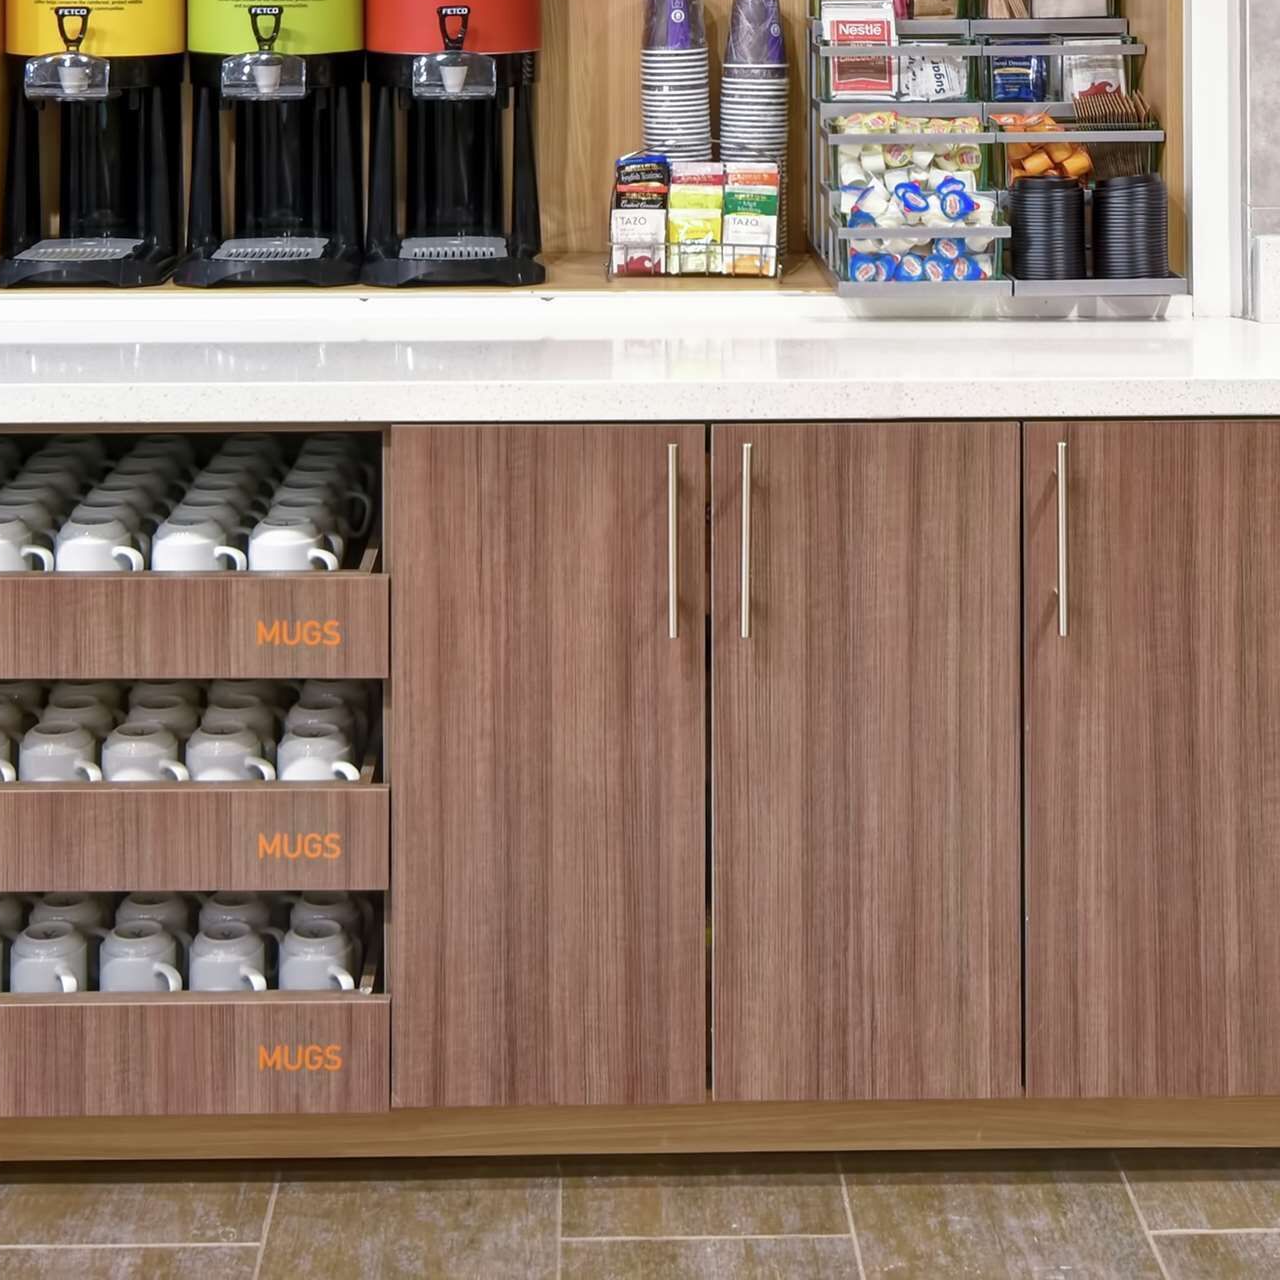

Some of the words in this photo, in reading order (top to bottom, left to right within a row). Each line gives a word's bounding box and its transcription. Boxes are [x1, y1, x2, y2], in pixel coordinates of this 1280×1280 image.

[257, 620, 342, 645] MUGS
[257, 832, 342, 857] MUGS
[257, 1045, 342, 1070] MUGS
